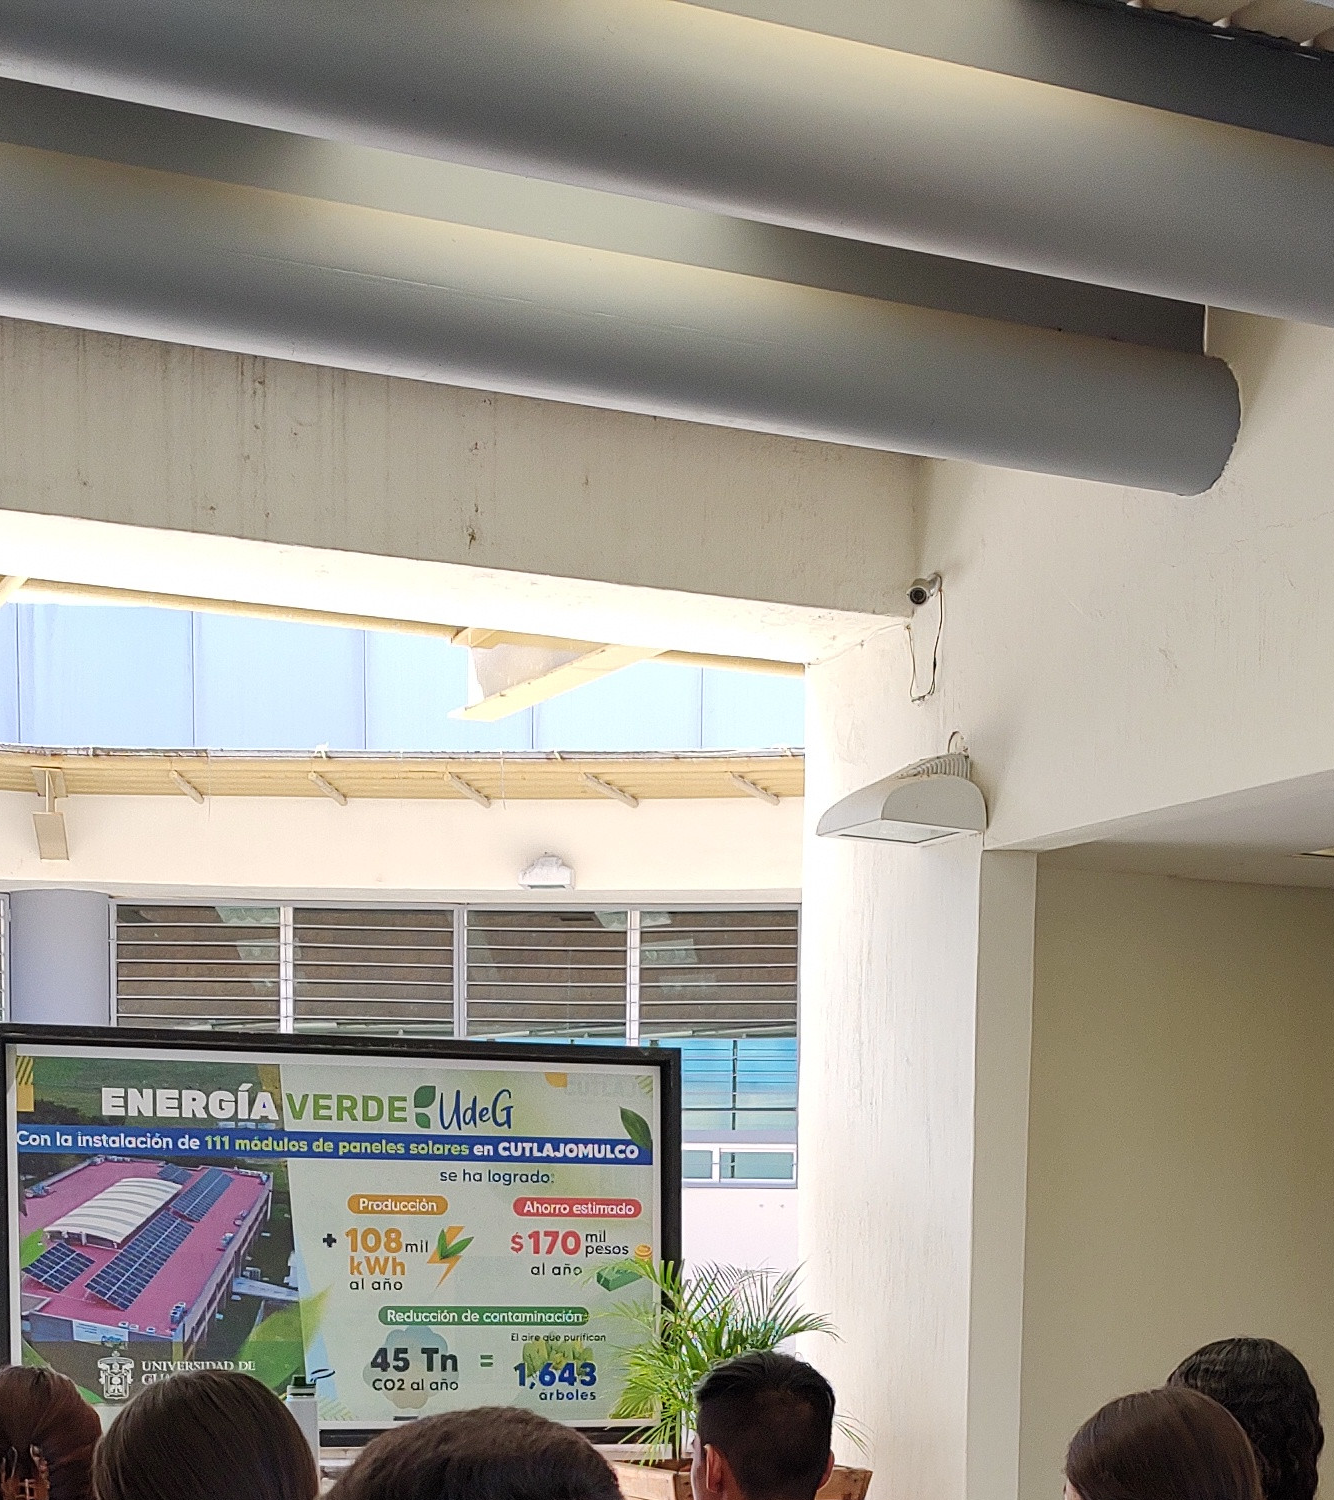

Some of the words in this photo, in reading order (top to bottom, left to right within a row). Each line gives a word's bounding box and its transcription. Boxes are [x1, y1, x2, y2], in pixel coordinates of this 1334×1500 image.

[101, 1083, 279, 1120] ENERGÍA
[286, 1092, 408, 1123] VERDE
[439, 1088, 514, 1130] UdeG
[17, 1130, 51, 1146] Con
[56, 1131, 72, 1147] la
[78, 1132, 173, 1150] instalación
[177, 1133, 199, 1150] de
[204, 1135, 229, 1151] 111
[235, 1135, 307, 1152] módulos
[312, 1136, 333, 1153] de
[338, 1139, 404, 1157] paneles
[410, 1140, 469, 1156] solares
[473, 1144, 493, 1156] en
[498, 1142, 639, 1159] CUTLAJOMULCO
[440, 1171, 458, 1182] se
[462, 1169, 482, 1182] ha
[488, 1169, 555, 1187] logrado:
[359, 1198, 437, 1212] Producción
[523, 1200, 569, 1214] Ahorro
[572, 1202, 634, 1215] estimado
[344, 1227, 403, 1254] 108
[404, 1240, 429, 1254] mil
[585, 1230, 606, 1243] mil
[585, 1244, 629, 1258] pesos
[349, 1256, 406, 1277] kWh
[530, 1263, 546, 1276] al
[551, 1263, 582, 1276] año
[349, 1279, 365, 1291] al
[371, 1279, 403, 1291] año
[387, 1309, 457, 1323] Reducción
[461, 1309, 479, 1323] de
[483, 1310, 582, 1323] contaminación
[522, 1333, 540, 1342] aire
[542, 1334, 561, 1344] que
[239, 1361, 255, 1371] DE
[370, 1347, 410, 1372] 45
[421, 1347, 458, 1372] Tn
[513, 1362, 597, 1390] 1,643
[372, 1379, 405, 1391] CO2
[410, 1378, 424, 1391] al
[429, 1378, 459, 1391] año
